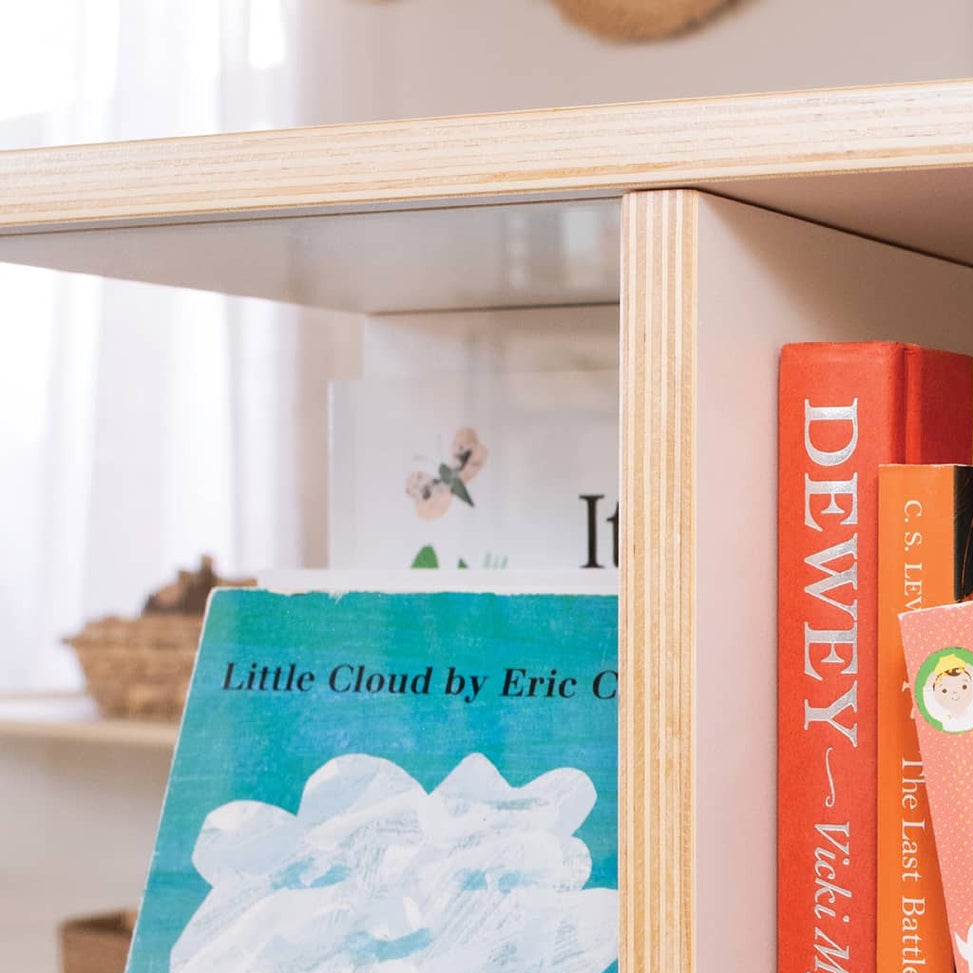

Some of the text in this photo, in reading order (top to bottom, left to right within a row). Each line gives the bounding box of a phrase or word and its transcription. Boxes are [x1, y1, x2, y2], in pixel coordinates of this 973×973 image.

[904, 500, 923, 523] C.
[904, 531, 922, 551] S.
[803, 398, 858, 747] DEWEY
[221, 662, 314, 692] Little
[329, 664, 432, 695] Cloud
[445, 667, 488, 703] by
[501, 668, 576, 698] Eric
[901, 759, 926, 810] The
[813, 821, 852, 923] Vicki
[901, 820, 925, 882] Last
